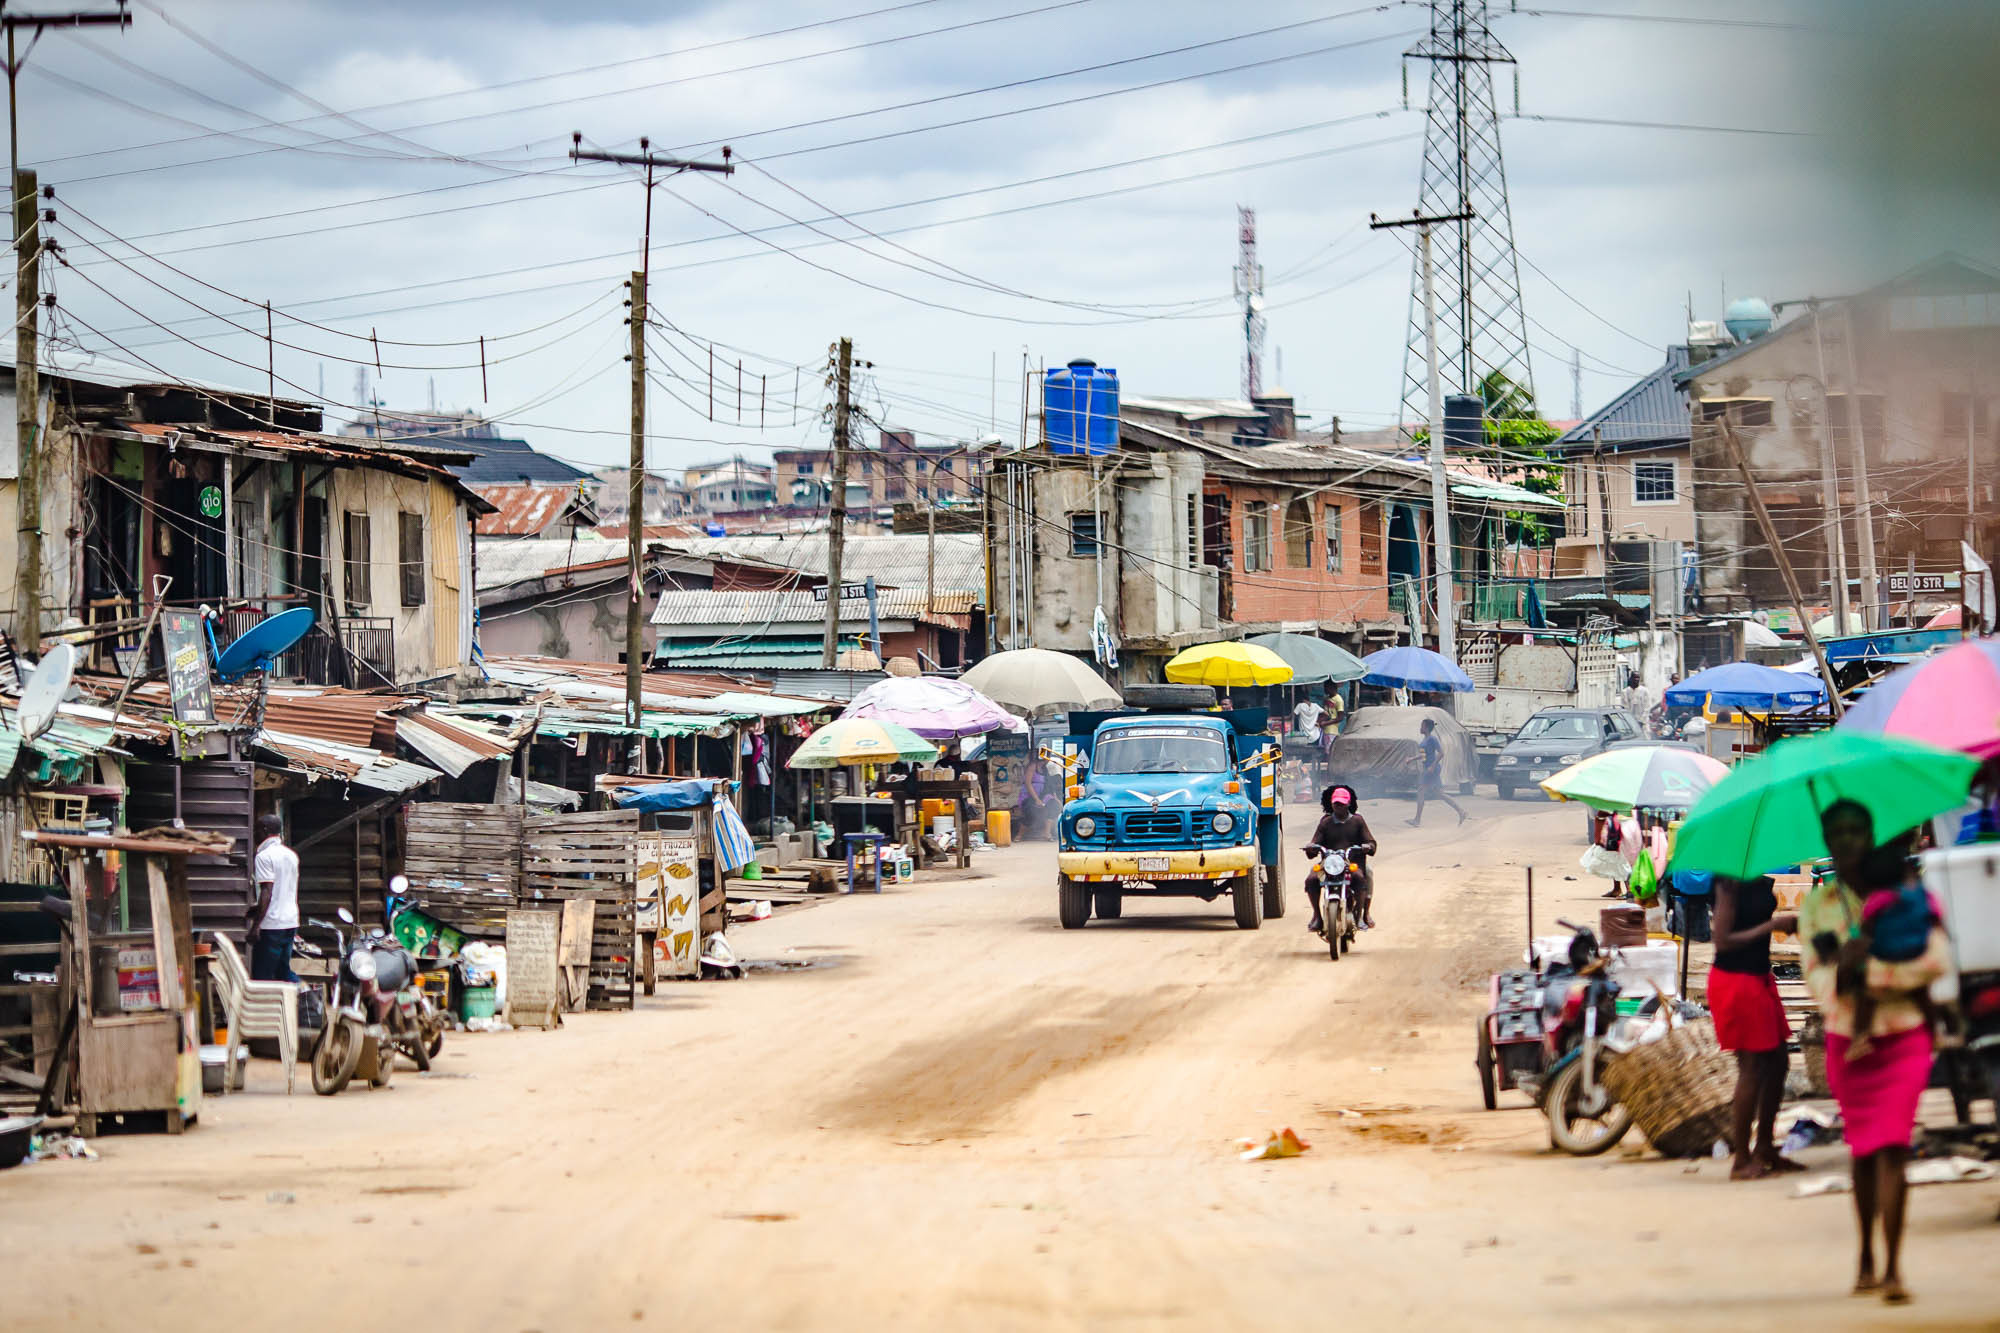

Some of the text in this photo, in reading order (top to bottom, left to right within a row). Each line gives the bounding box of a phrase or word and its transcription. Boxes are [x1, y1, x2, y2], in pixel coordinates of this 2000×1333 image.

[203, 494, 220, 512] glo
[1890, 577, 1942, 589] BELO STR
[849, 586, 866, 598] STR
[663, 841, 692, 849] FROZEN
